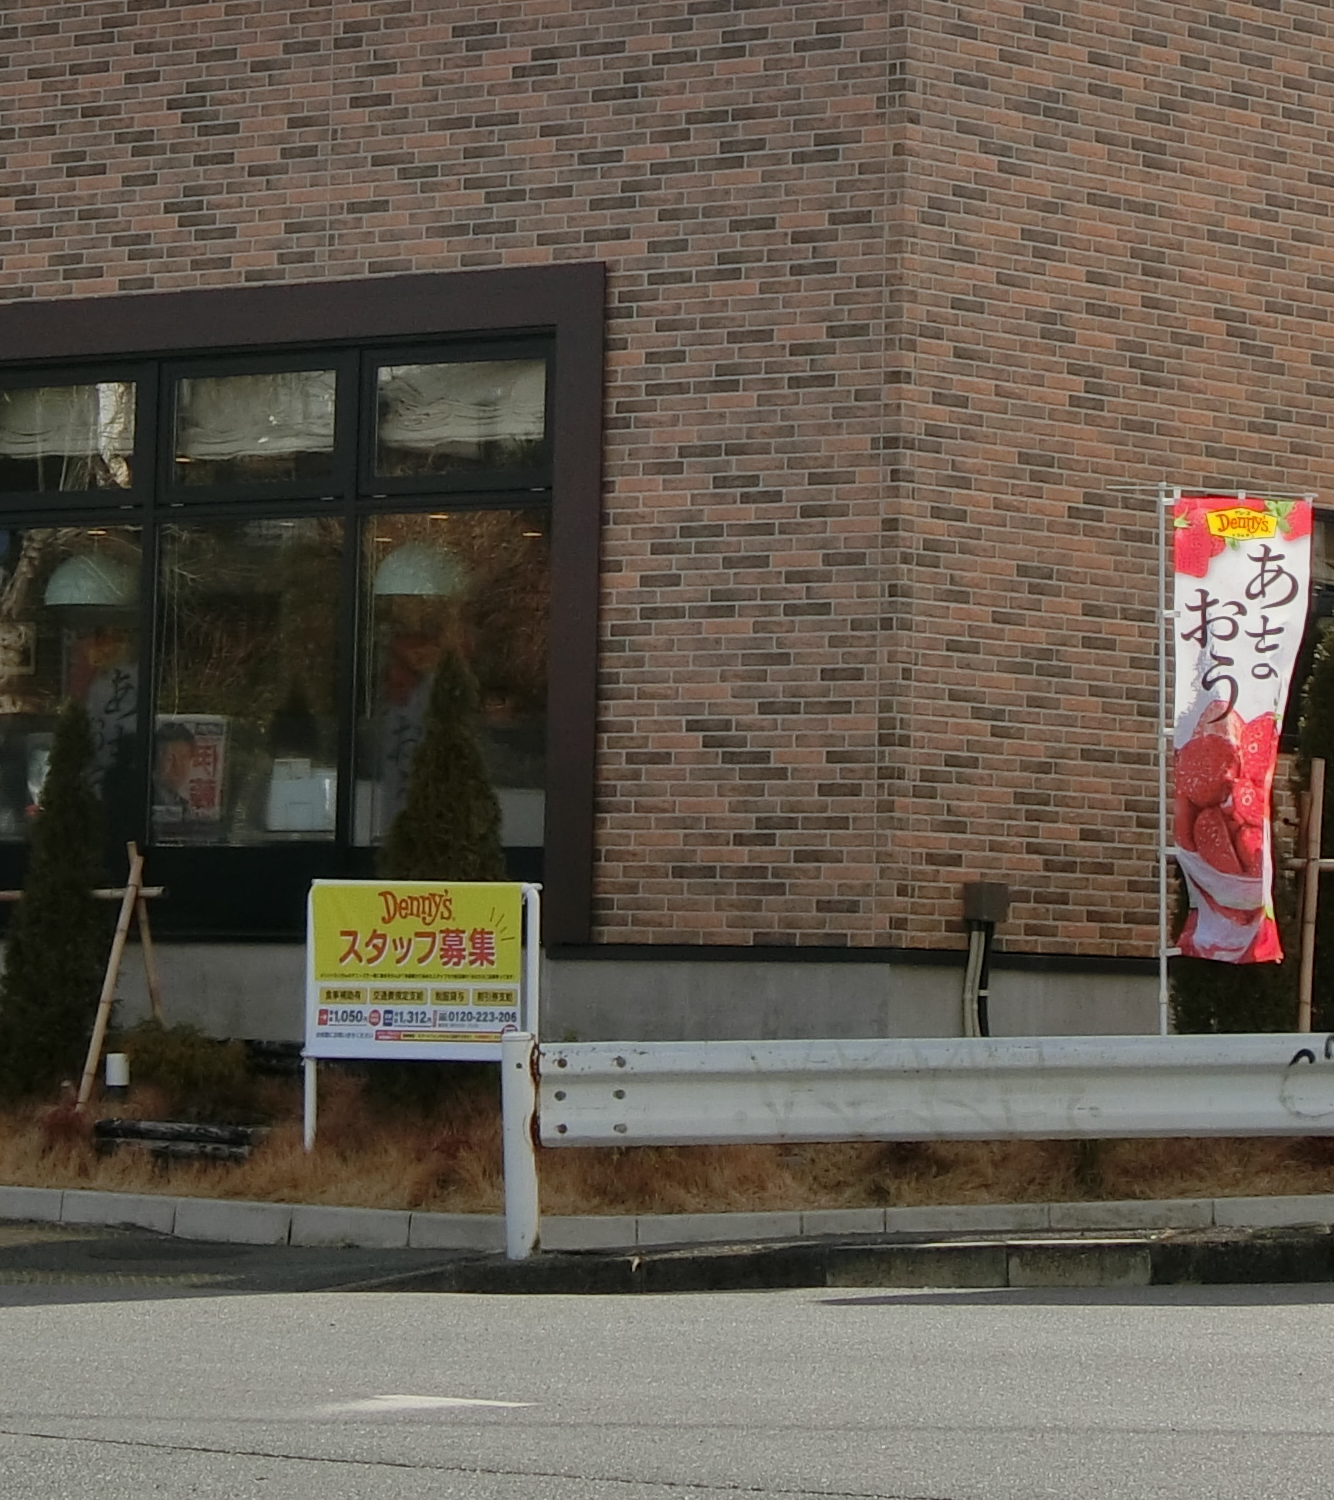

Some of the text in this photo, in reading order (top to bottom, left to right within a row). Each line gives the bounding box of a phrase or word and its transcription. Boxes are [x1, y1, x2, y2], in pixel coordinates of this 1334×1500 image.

[1215, 514, 1269, 534] Denny's
[378, 889, 453, 925] Denny's
[338, 928, 496, 967] スタッフ募集
